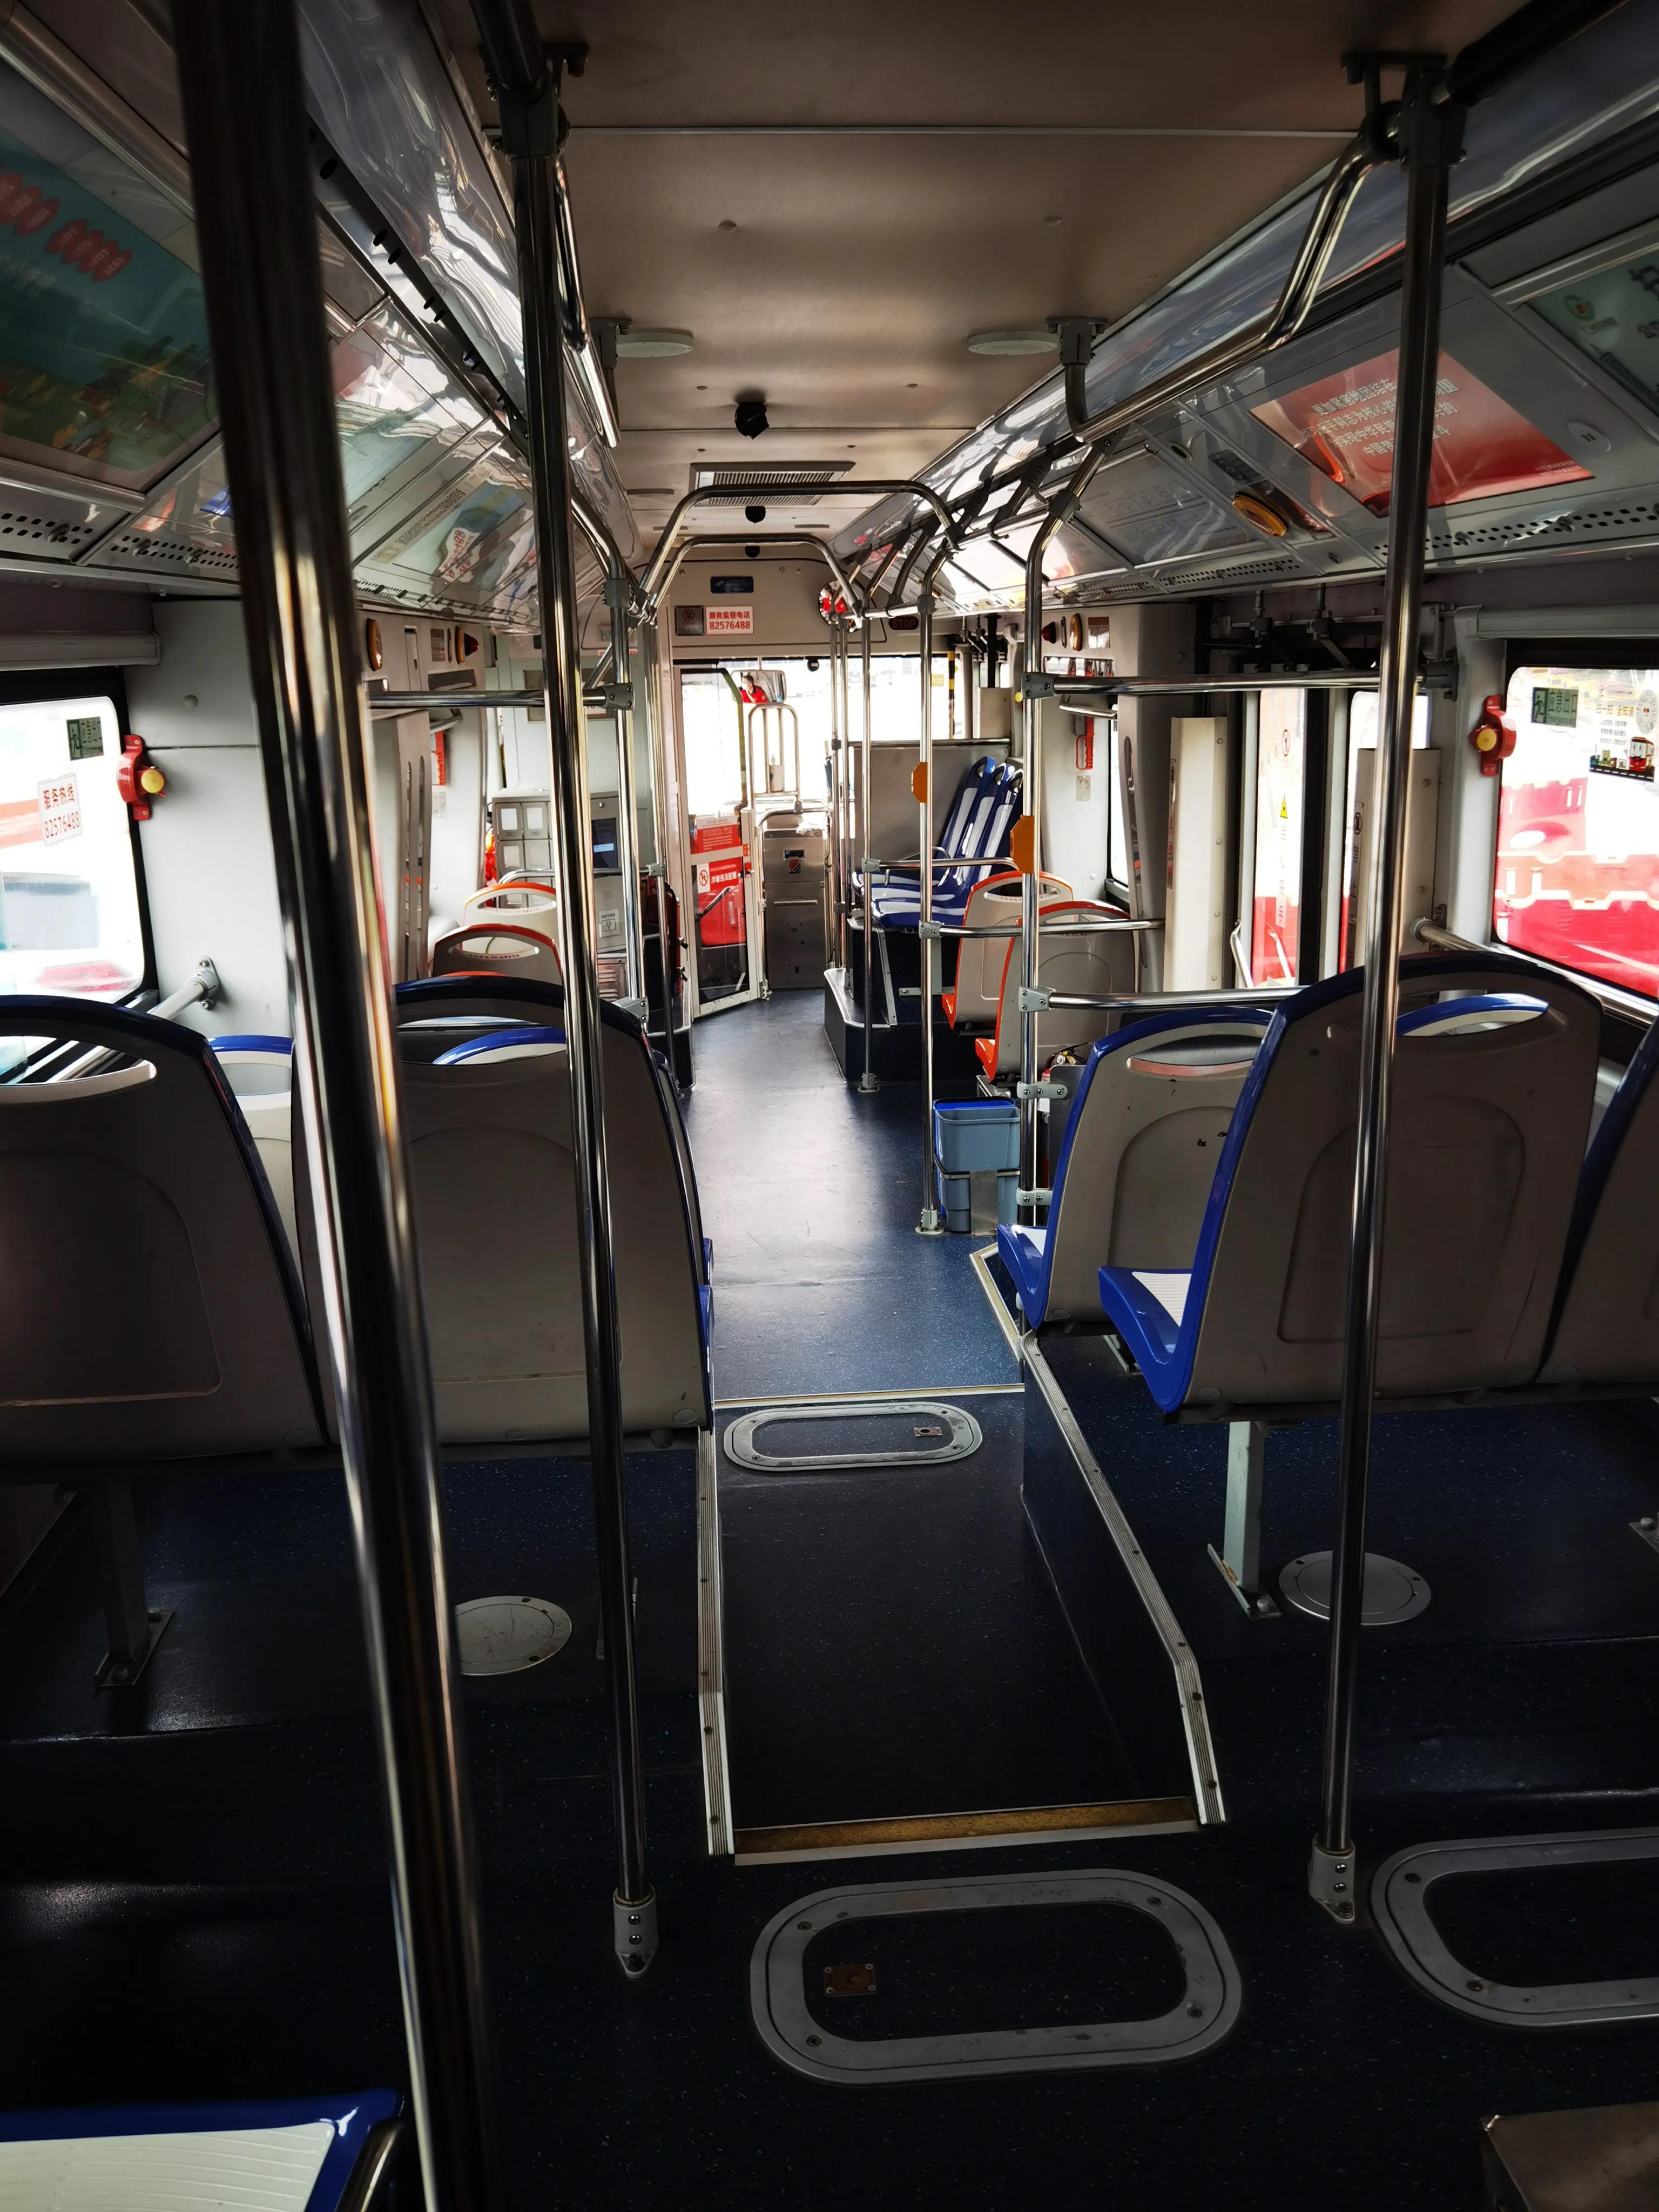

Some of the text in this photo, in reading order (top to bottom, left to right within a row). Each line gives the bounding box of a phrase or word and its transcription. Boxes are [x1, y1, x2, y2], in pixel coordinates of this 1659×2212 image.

[709, 611, 750, 619] 服务监督电话
[709, 621, 751, 630] 82576488
[892, 618, 916, 628] STOP
[44, 811, 80, 838] 82576488
